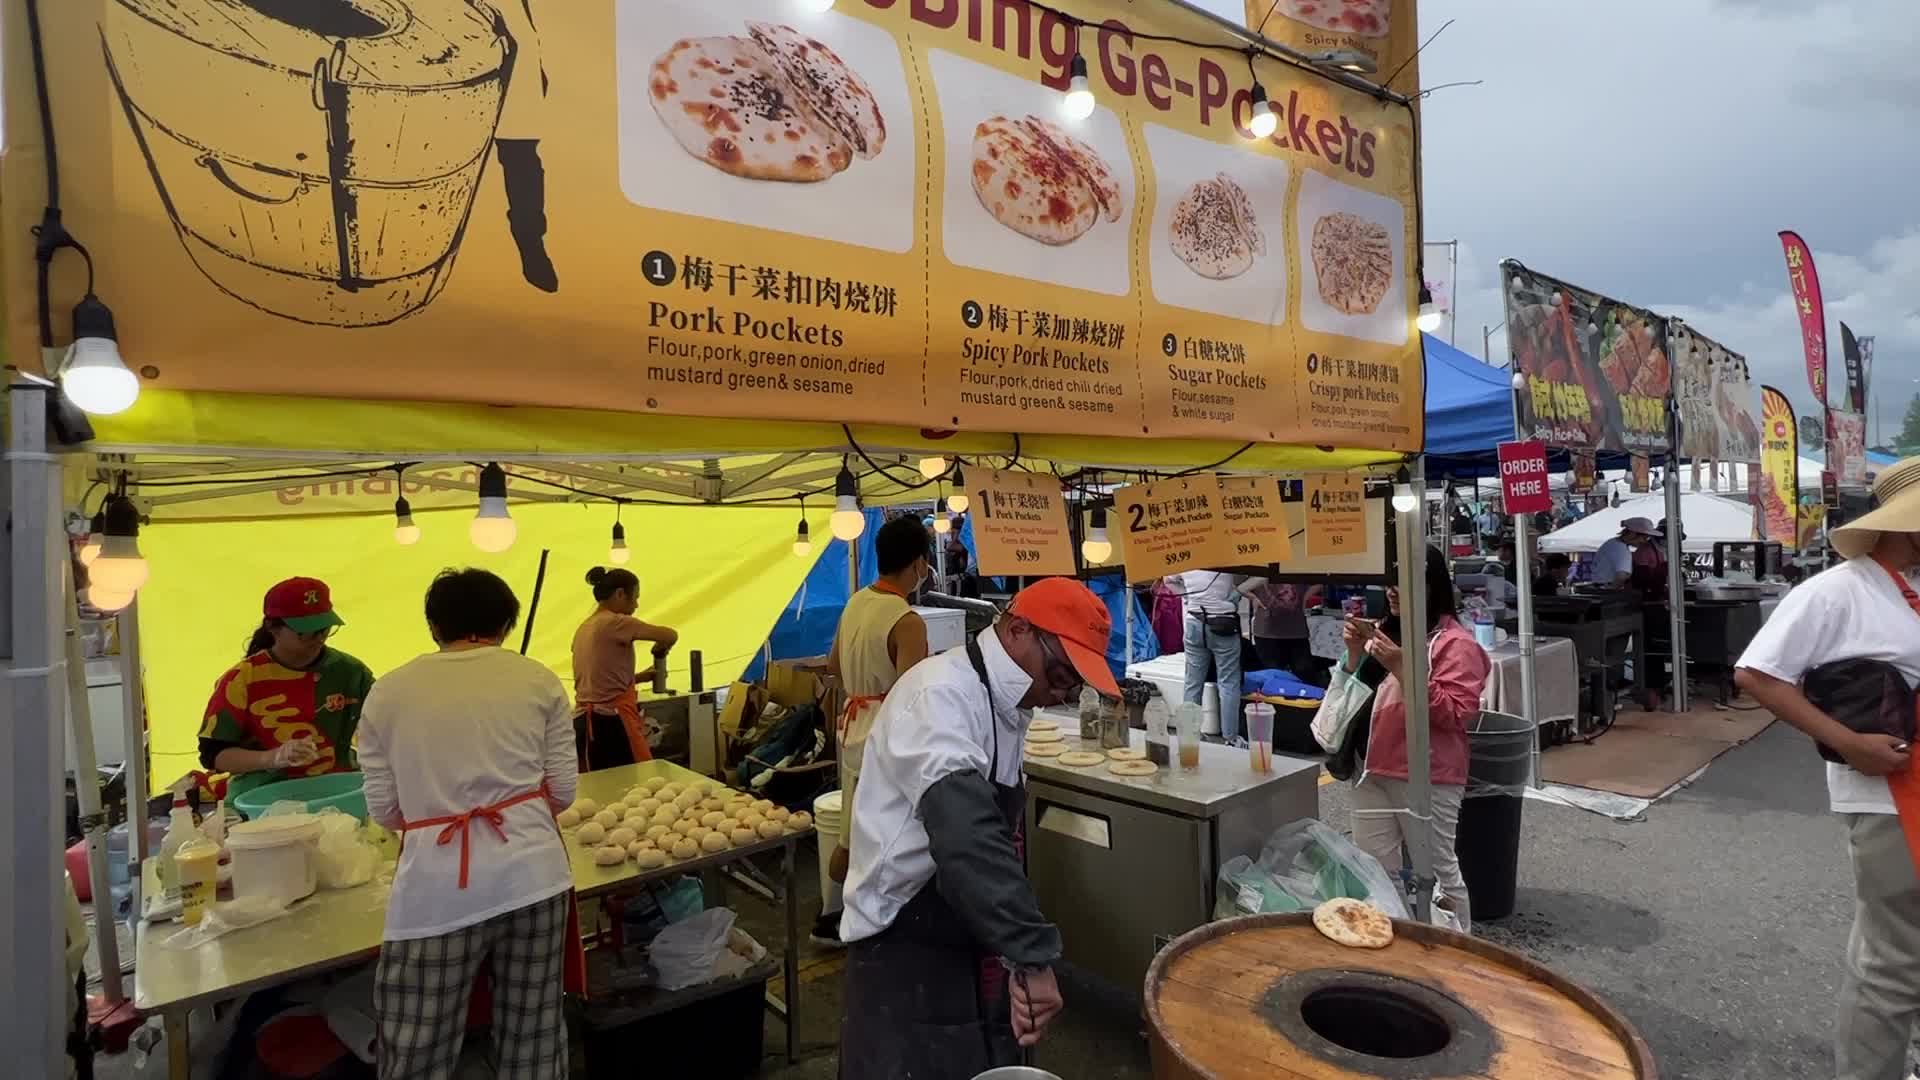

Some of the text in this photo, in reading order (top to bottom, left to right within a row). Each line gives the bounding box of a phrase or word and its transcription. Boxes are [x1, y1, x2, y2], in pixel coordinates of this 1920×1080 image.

[680, 255, 899, 318] 梅干菜扣肉烧饼
[648, 301, 844, 348] Pork Pockets
[987, 303, 1126, 350] 梅干菜加辣烧饼
[962, 336, 1110, 375] Spicy Pork Pockets
[1184, 336, 1247, 365] 白糖烧饼
[647, 366, 724, 386] mustard
[793, 378, 854, 395] sesame
[1168, 364, 1267, 392] Sugar Pockets
[1309, 379, 1341, 403] Crispy
[1366, 387, 1400, 405] Pockets
[960, 390, 1017, 407] mustard
[1068, 399, 1114, 414] sesame
[1181, 406, 1207, 420] white
[1208, 410, 1235, 424] sugar
[1502, 459, 1545, 497] ORDER HERE
[978, 489, 991, 518] 1
[1311, 489, 1322, 512] 4
[1127, 503, 1147, 533] 2
[1016, 549, 1040, 562] $9.99
[1165, 550, 1191, 565] $9.99
[1237, 543, 1260, 555] $9.99
